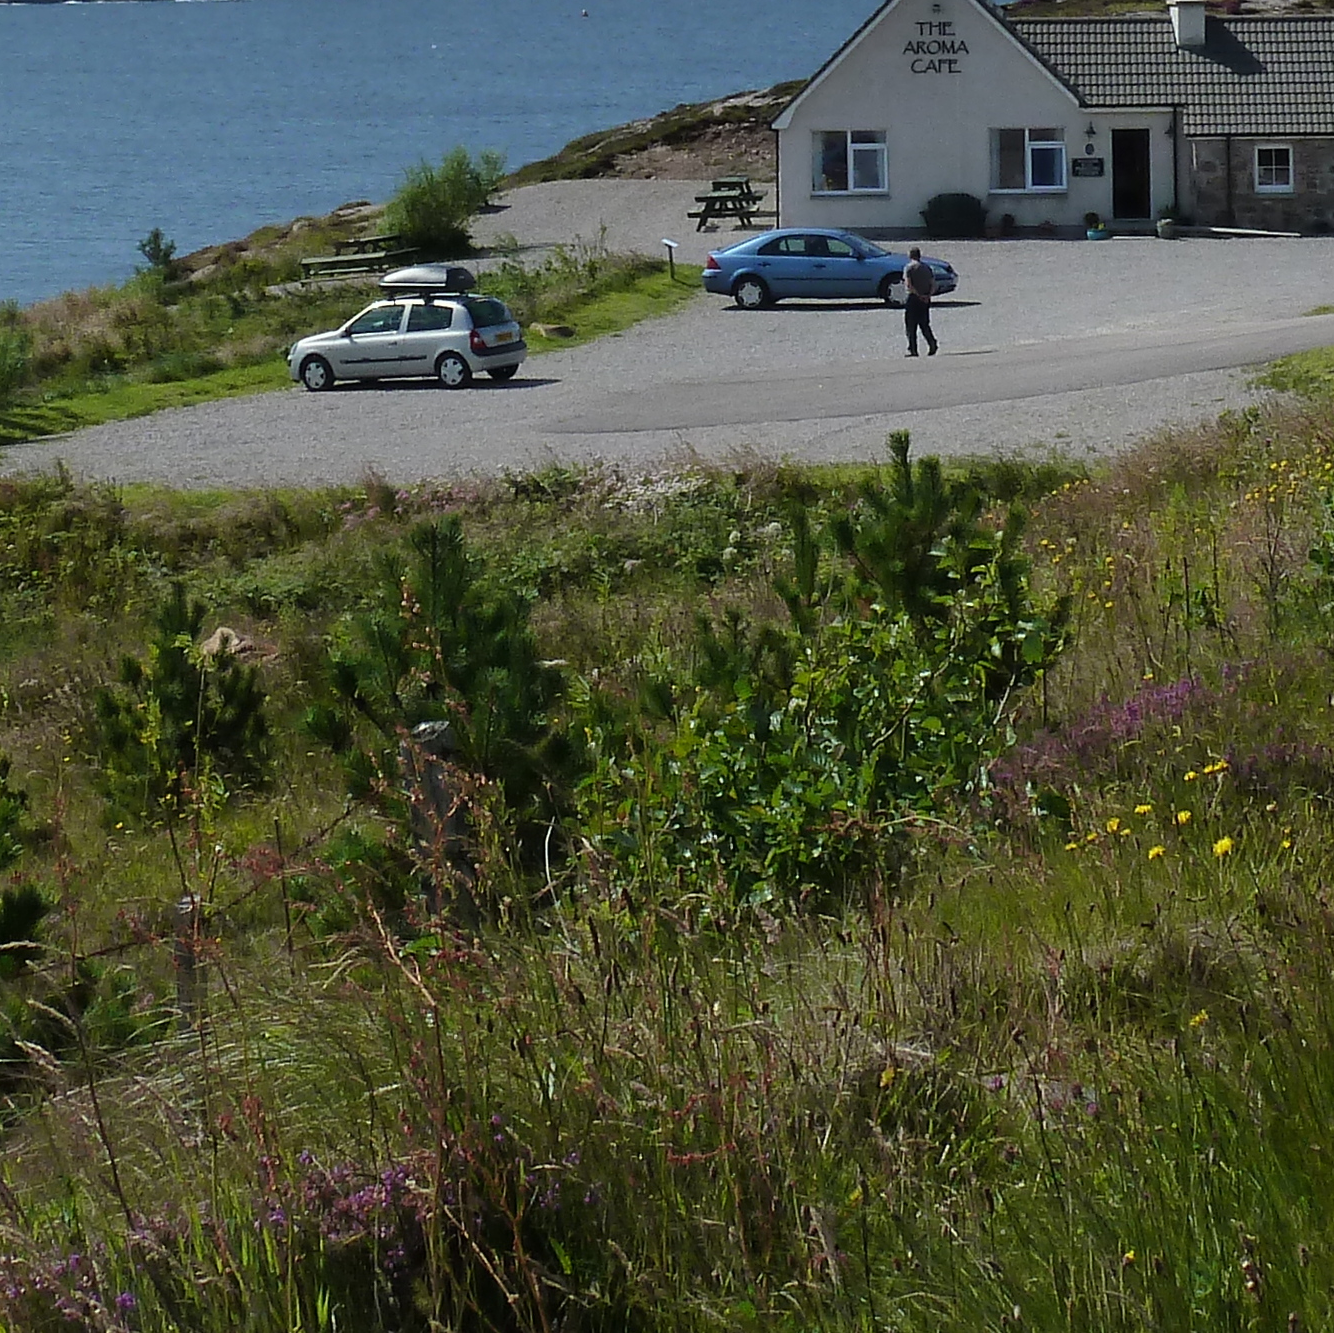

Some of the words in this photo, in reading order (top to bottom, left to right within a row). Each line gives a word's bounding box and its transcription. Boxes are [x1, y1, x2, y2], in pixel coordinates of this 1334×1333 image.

[915, 21, 956, 36] THE
[903, 40, 970, 54] AROMA
[910, 59, 962, 74] CAFE
